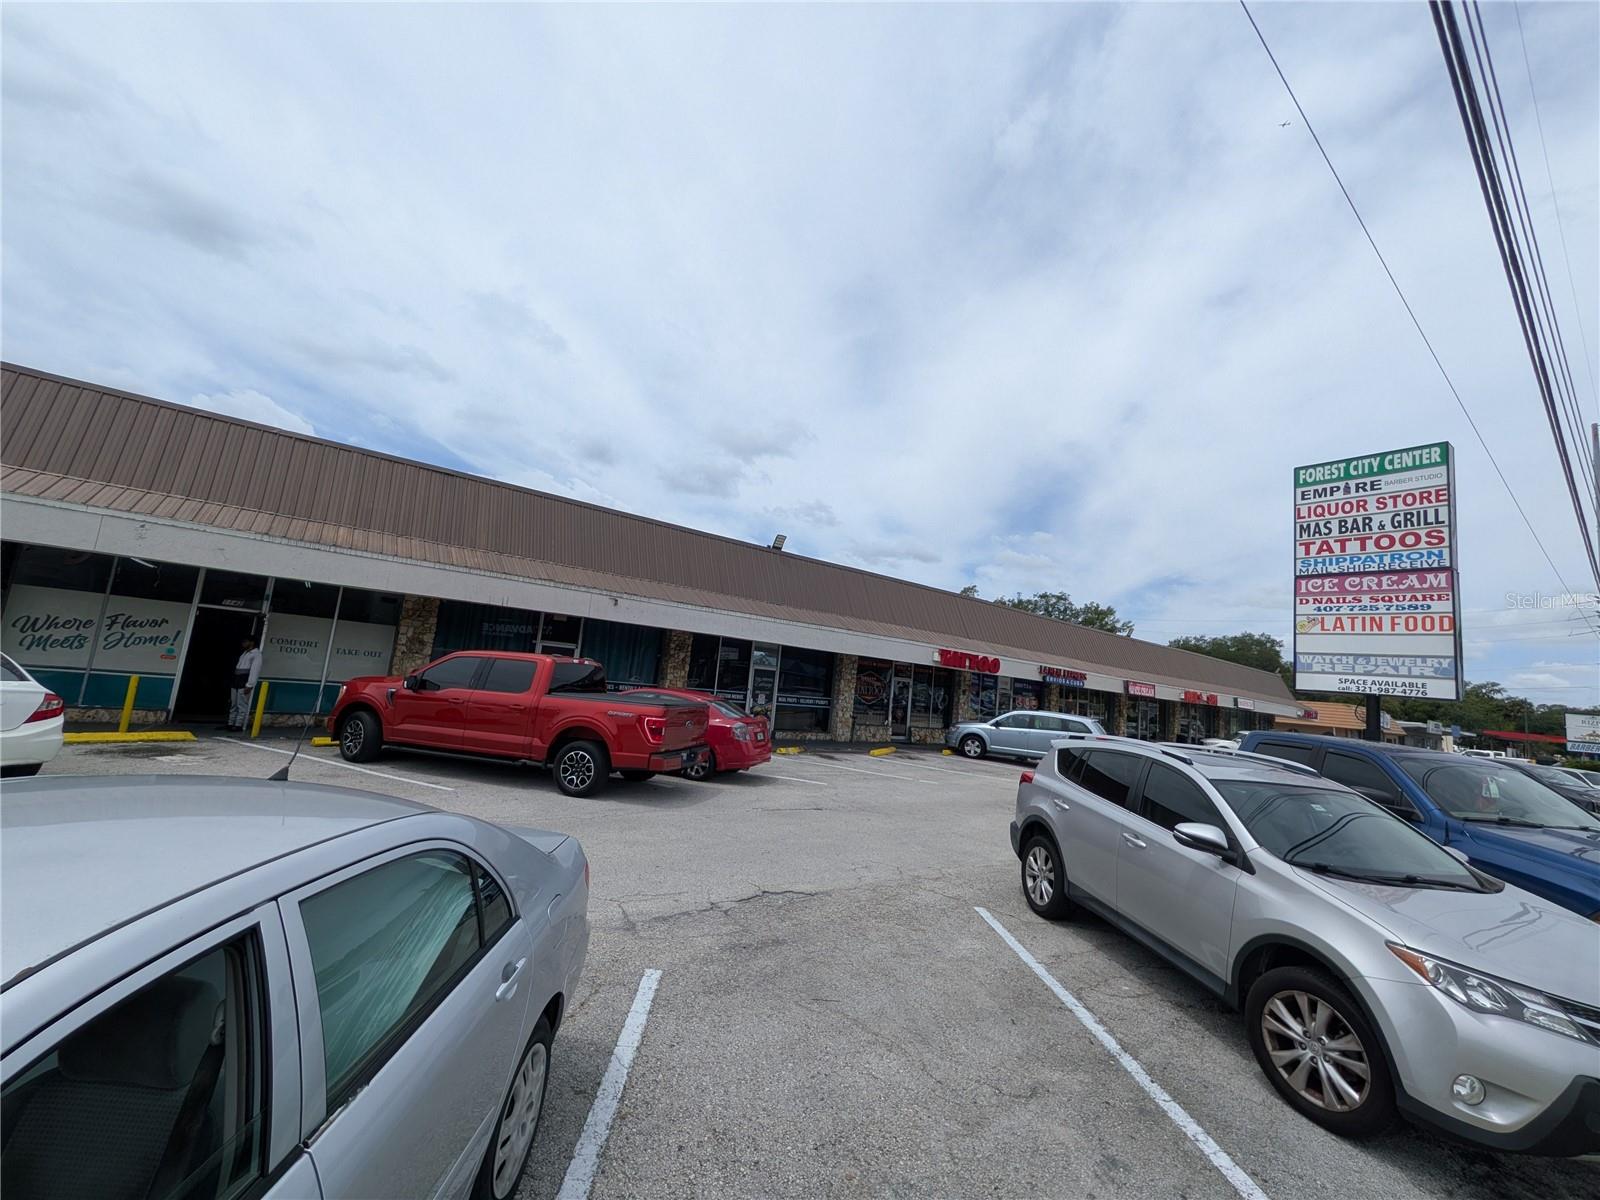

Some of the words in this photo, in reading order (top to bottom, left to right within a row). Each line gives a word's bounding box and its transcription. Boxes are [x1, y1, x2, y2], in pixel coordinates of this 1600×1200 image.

[1299, 463, 1346, 484] FOREST
[1350, 457, 1380, 476] CITY
[1384, 447, 1441, 470] CENTER
[1384, 476, 1414, 486] BARBER
[1415, 472, 1443, 482] STUDIO
[1296, 499, 1368, 520] LIQUOR
[1375, 488, 1449, 511] STORE
[1299, 520, 1333, 539] MAS
[1338, 516, 1373, 535] BAR
[1377, 520, 1386, 531] &
[1391, 508, 1445, 530] GRILL
[1299, 529, 1446, 556] TATTOOS
[1300, 549, 1444, 568] SHIPPATRON
[1299, 577, 1339, 593] ICE
[1344, 572, 1449, 591] CREAM
[1298, 597, 1310, 605] D
[1312, 596, 1362, 605] NAILS
[1369, 593, 1450, 604] SQUARE
[11, 613, 96, 634] Where
[105, 612, 169, 631] Flavor
[1319, 615, 1383, 632] LATIN
[1390, 615, 1454, 632] FOOD
[19, 633, 88, 652] Meets
[102, 630, 181, 650] Home!
[270, 637, 320, 649] COMFORT
[279, 646, 308, 655] FOOD
[335, 647, 360, 656] TAKE
[363, 650, 384, 658] OUT
[938, 648, 1001, 673] TATTOO
[1298, 655, 1353, 664] WATCH
[1356, 655, 1367, 665] &
[1369, 656, 1452, 668] JEWELRY
[1311, 663, 1437, 677] REPAIR
[1338, 677, 1368, 686] SPACE
[1370, 680, 1428, 689] AVAILABLE
[1354, 686, 1428, 696] 321-987-4776
